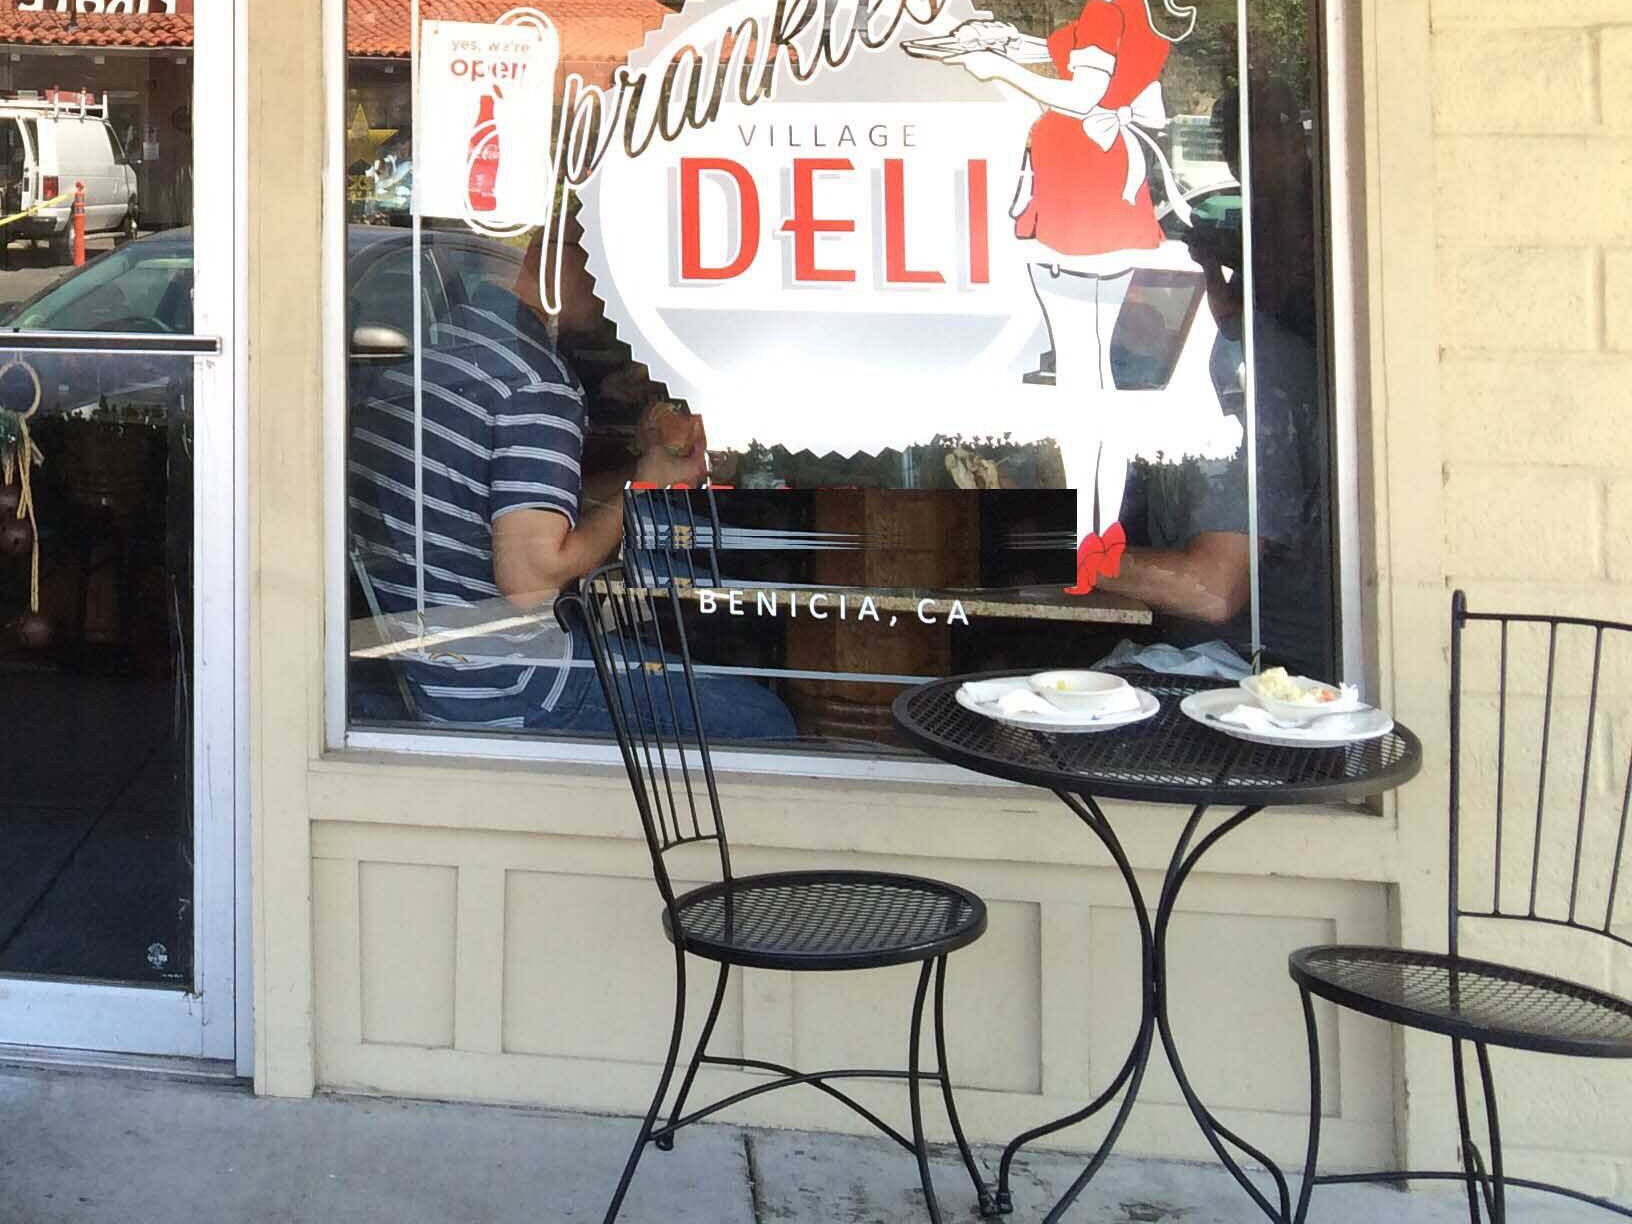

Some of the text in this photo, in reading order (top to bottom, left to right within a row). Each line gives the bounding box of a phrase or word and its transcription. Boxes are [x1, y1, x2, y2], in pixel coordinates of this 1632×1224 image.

[737, 123, 921, 148] VILLAGE
[674, 156, 991, 286] DELI
[699, 590, 969, 628] BENICIA, CA
